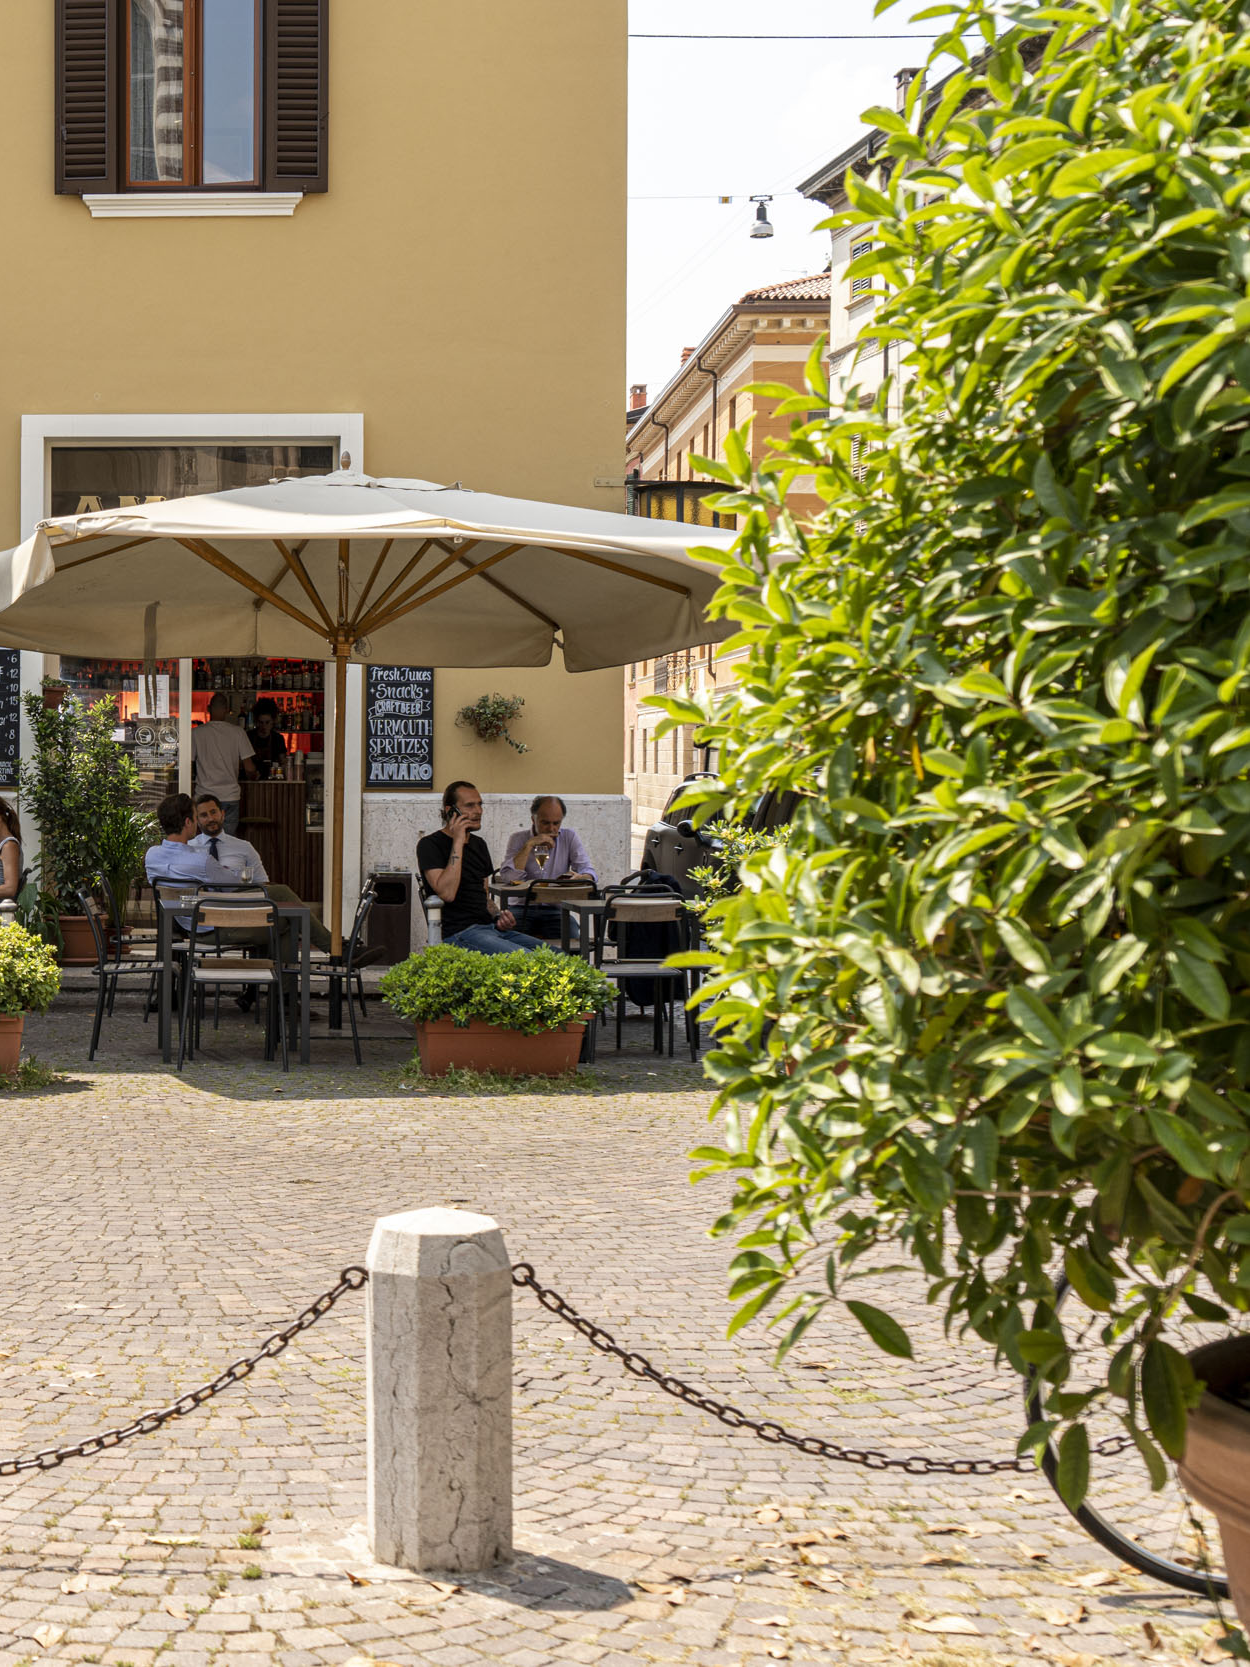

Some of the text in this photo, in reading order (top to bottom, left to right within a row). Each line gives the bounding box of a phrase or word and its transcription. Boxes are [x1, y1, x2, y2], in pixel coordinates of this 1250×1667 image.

[370, 666, 431, 681] Fresh Juices
[375, 683, 423, 699] Snacks
[370, 719, 433, 735] VERMOUTH
[369, 738, 429, 753] SPRITZES
[370, 763, 433, 780] AMARO
